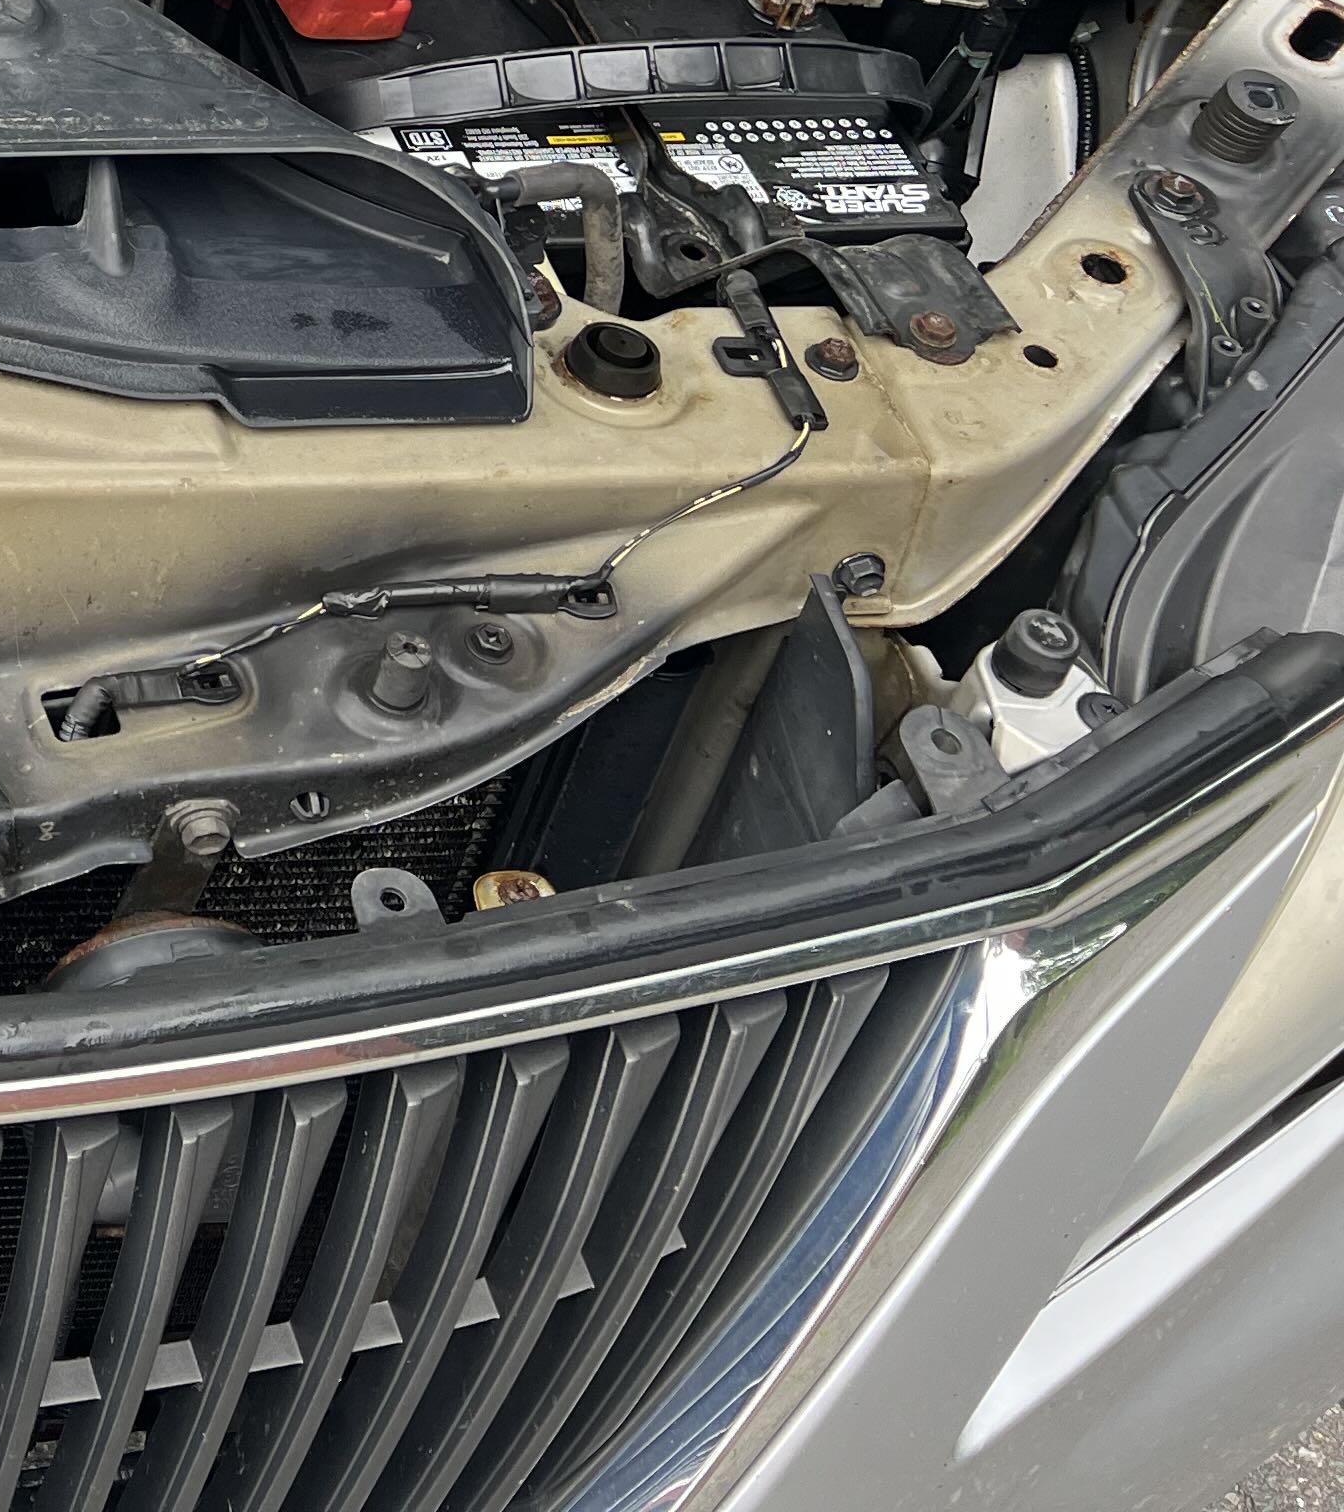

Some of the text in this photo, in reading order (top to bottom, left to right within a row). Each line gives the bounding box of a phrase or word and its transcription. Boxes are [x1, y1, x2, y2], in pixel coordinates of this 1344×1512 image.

[409, 131, 446, 146] STD
[820, 183, 930, 201] START
[825, 199, 927, 214] SUPER
